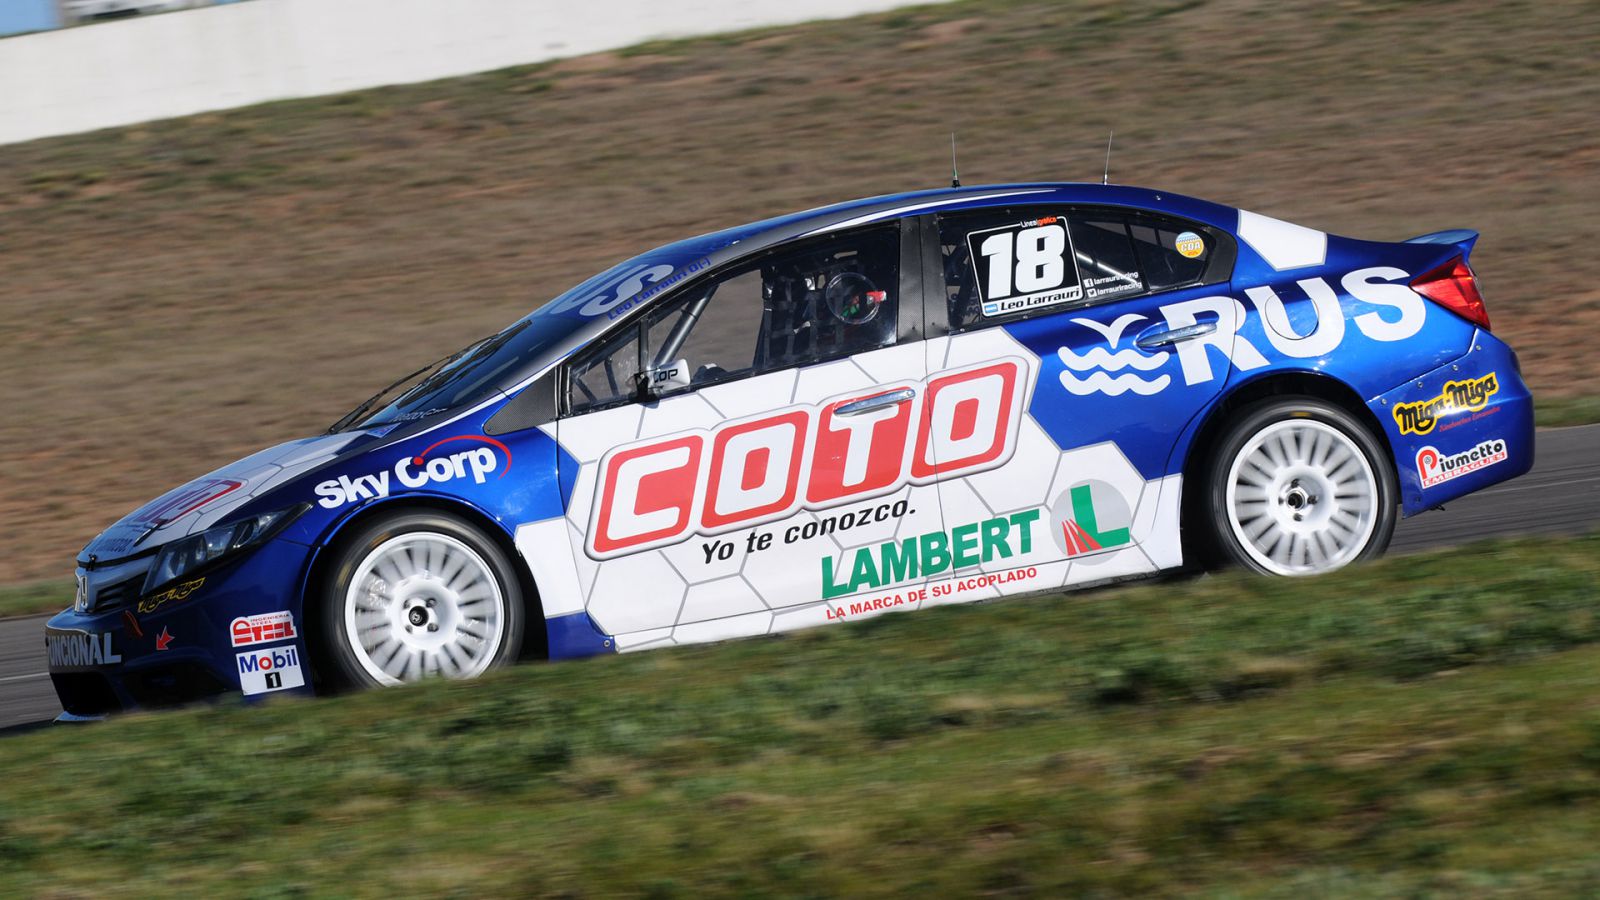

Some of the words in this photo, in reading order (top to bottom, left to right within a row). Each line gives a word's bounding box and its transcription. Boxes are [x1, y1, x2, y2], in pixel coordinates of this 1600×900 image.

[981, 225, 1066, 300] 18
[999, 301, 1023, 312] Leo
[1026, 286, 1081, 307] Larrauri
[1158, 266, 1427, 387] RUS
[1394, 374, 1498, 434] Miga-Miga
[313, 470, 390, 509] Sky
[394, 447, 497, 489] Corp
[596, 363, 1014, 550] COTO
[1417, 442, 1503, 480] Piumetto
[702, 539, 735, 564] Yo
[746, 532, 773, 554] te
[783, 499, 917, 545] conozco.
[820, 509, 1040, 600] LAMBERT
[826, 606, 847, 621] LA
[849, 595, 904, 615] MARCA
[907, 588, 929, 605] DE
[931, 584, 953, 598] SU
[956, 567, 1038, 594] ACOPLADO
[47, 631, 122, 667] UNCIONAL
[238, 649, 298, 674] Mobil
[268, 673, 280, 688] 1
